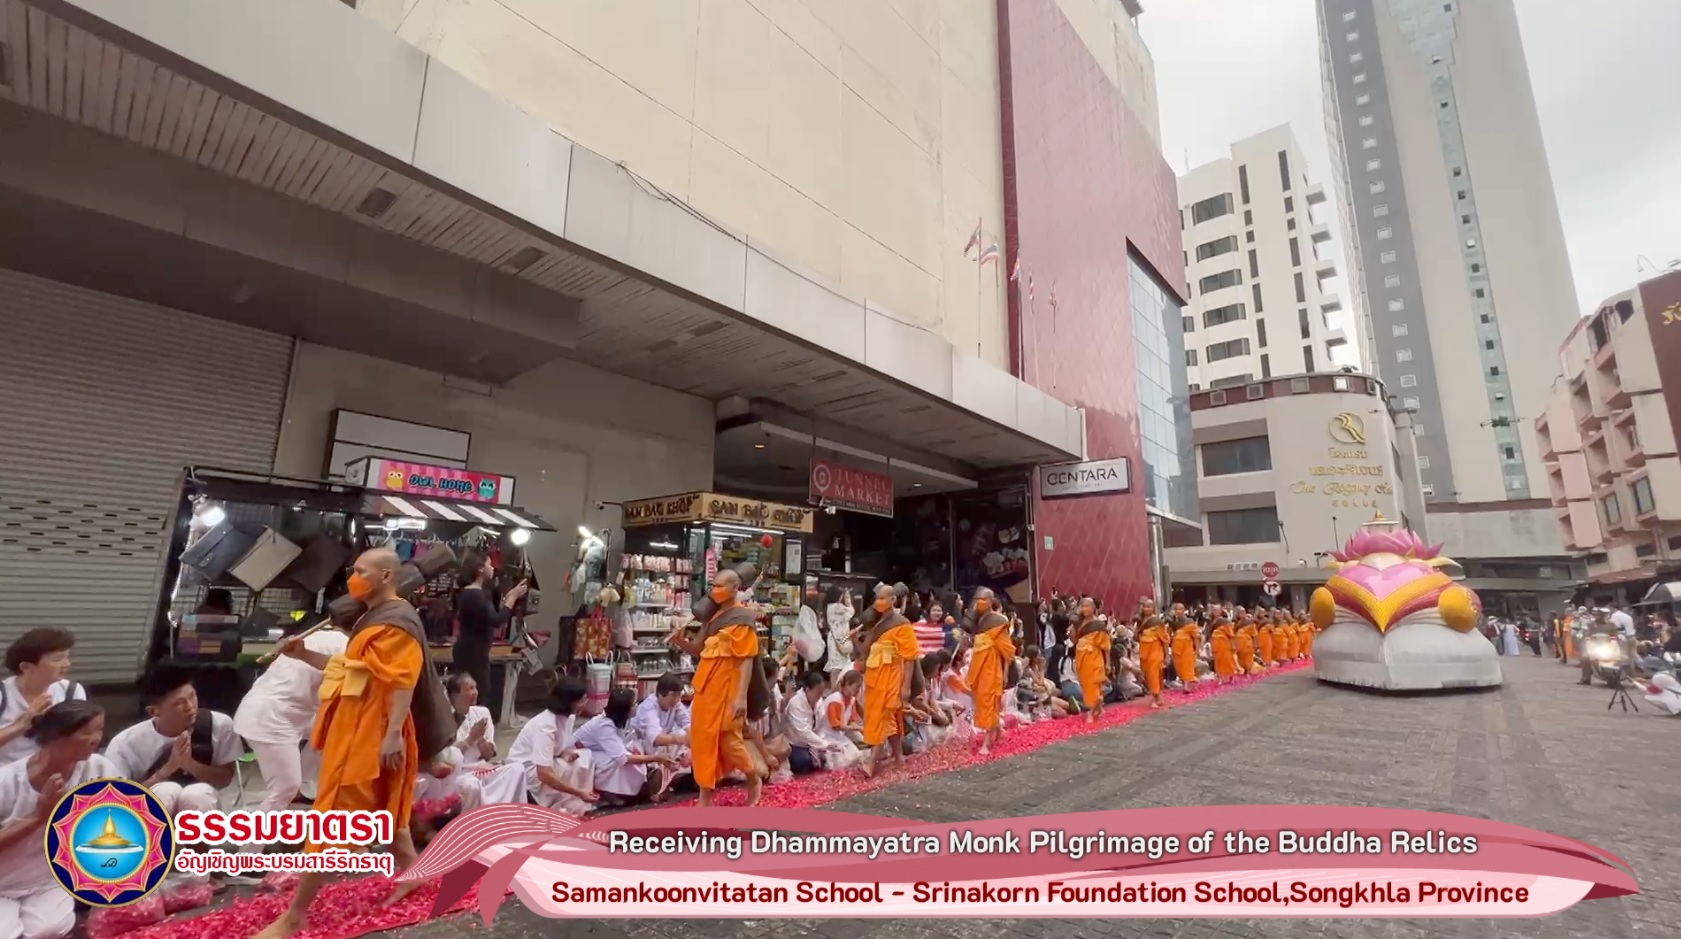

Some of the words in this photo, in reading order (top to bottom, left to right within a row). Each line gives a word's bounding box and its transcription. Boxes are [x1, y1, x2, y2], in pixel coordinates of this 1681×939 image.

[409, 474, 437, 488] OWL
[439, 477, 472, 494] HOME
[834, 469, 890, 492] TUNNEL
[1047, 467, 1118, 486] CENTARA
[834, 484, 890, 506] MARKET
[710, 499, 738, 516] SAN
